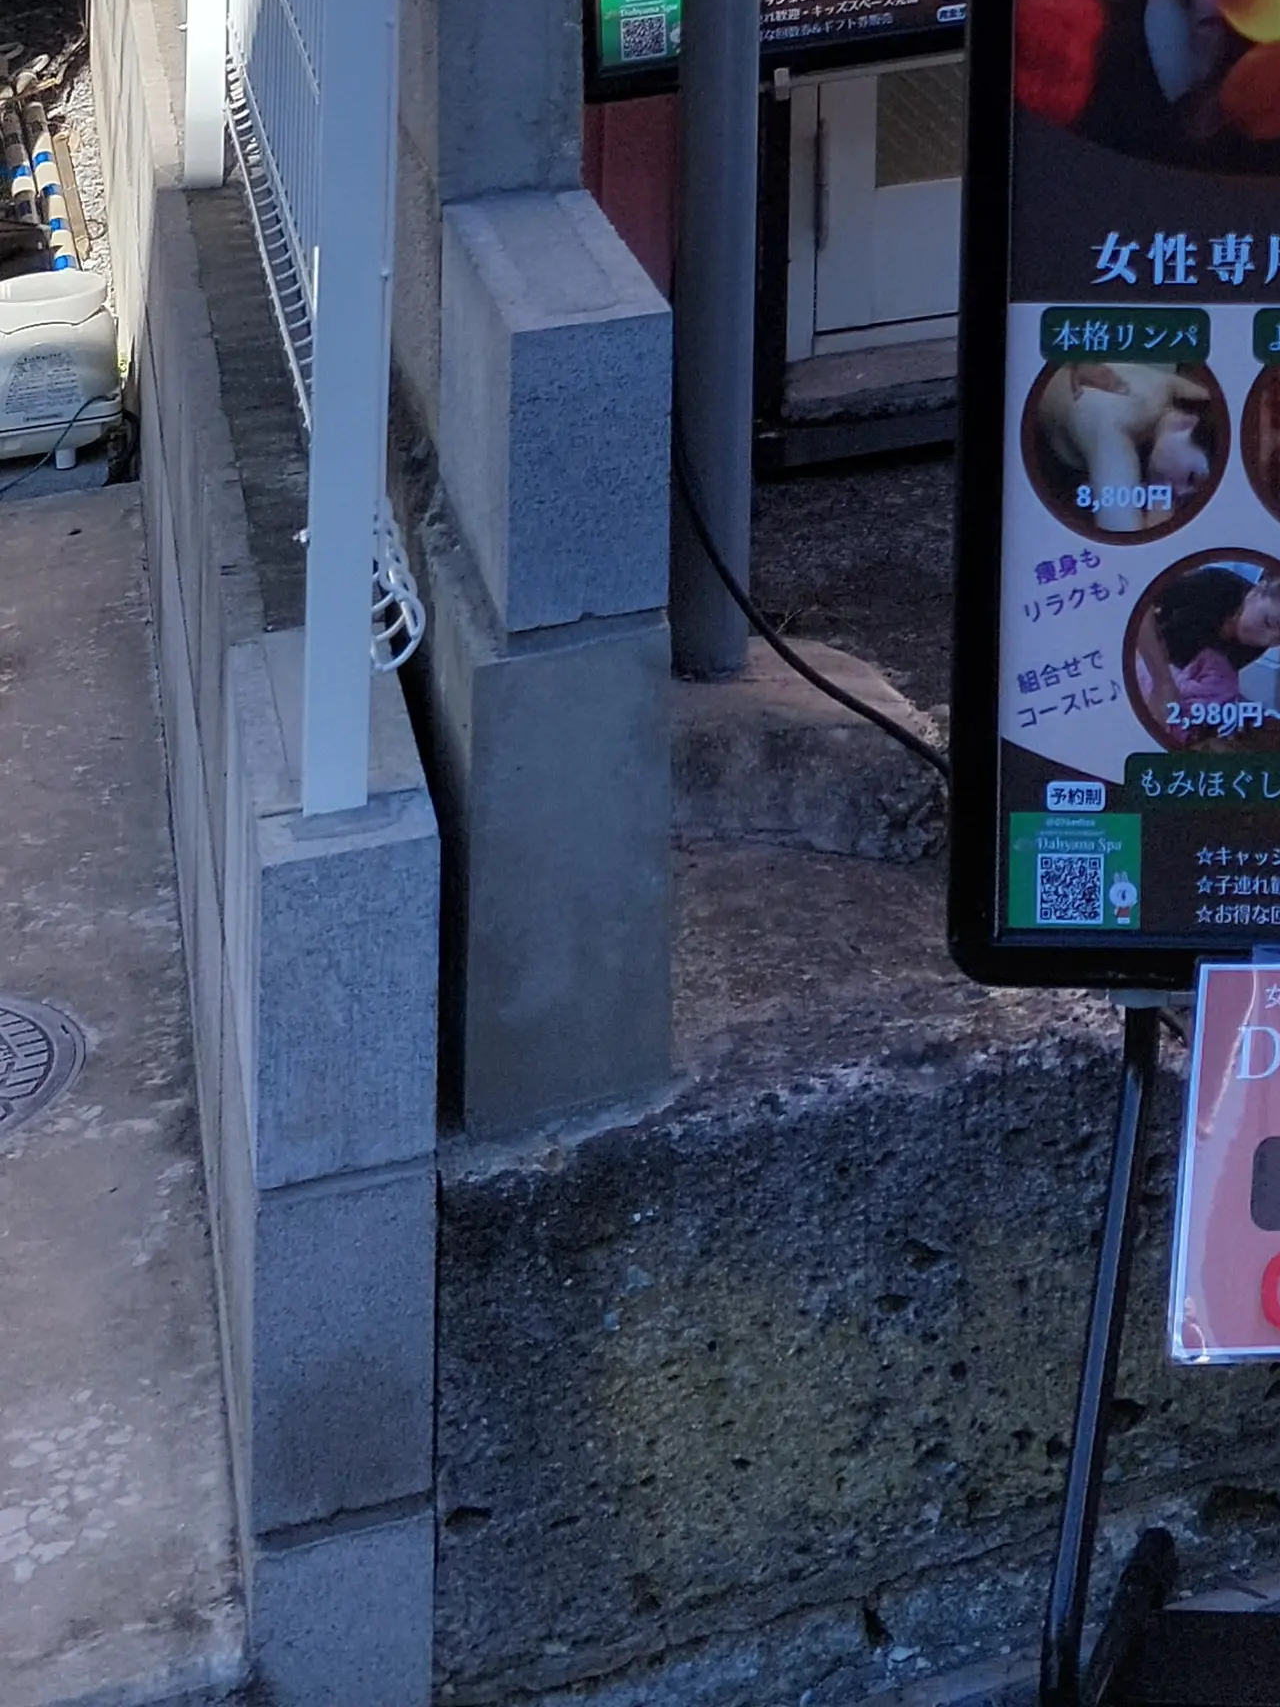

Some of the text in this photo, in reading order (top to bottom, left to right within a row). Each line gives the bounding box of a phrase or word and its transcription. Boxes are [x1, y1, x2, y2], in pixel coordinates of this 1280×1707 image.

[1052, 320, 1198, 353] 本格リンパ
[1075, 485, 1173, 513] 8,800円
[1016, 649, 1104, 695] 組合せで
[1050, 787, 1103, 806] 予約制
[1036, 837, 1122, 854] Dahyana Spa
